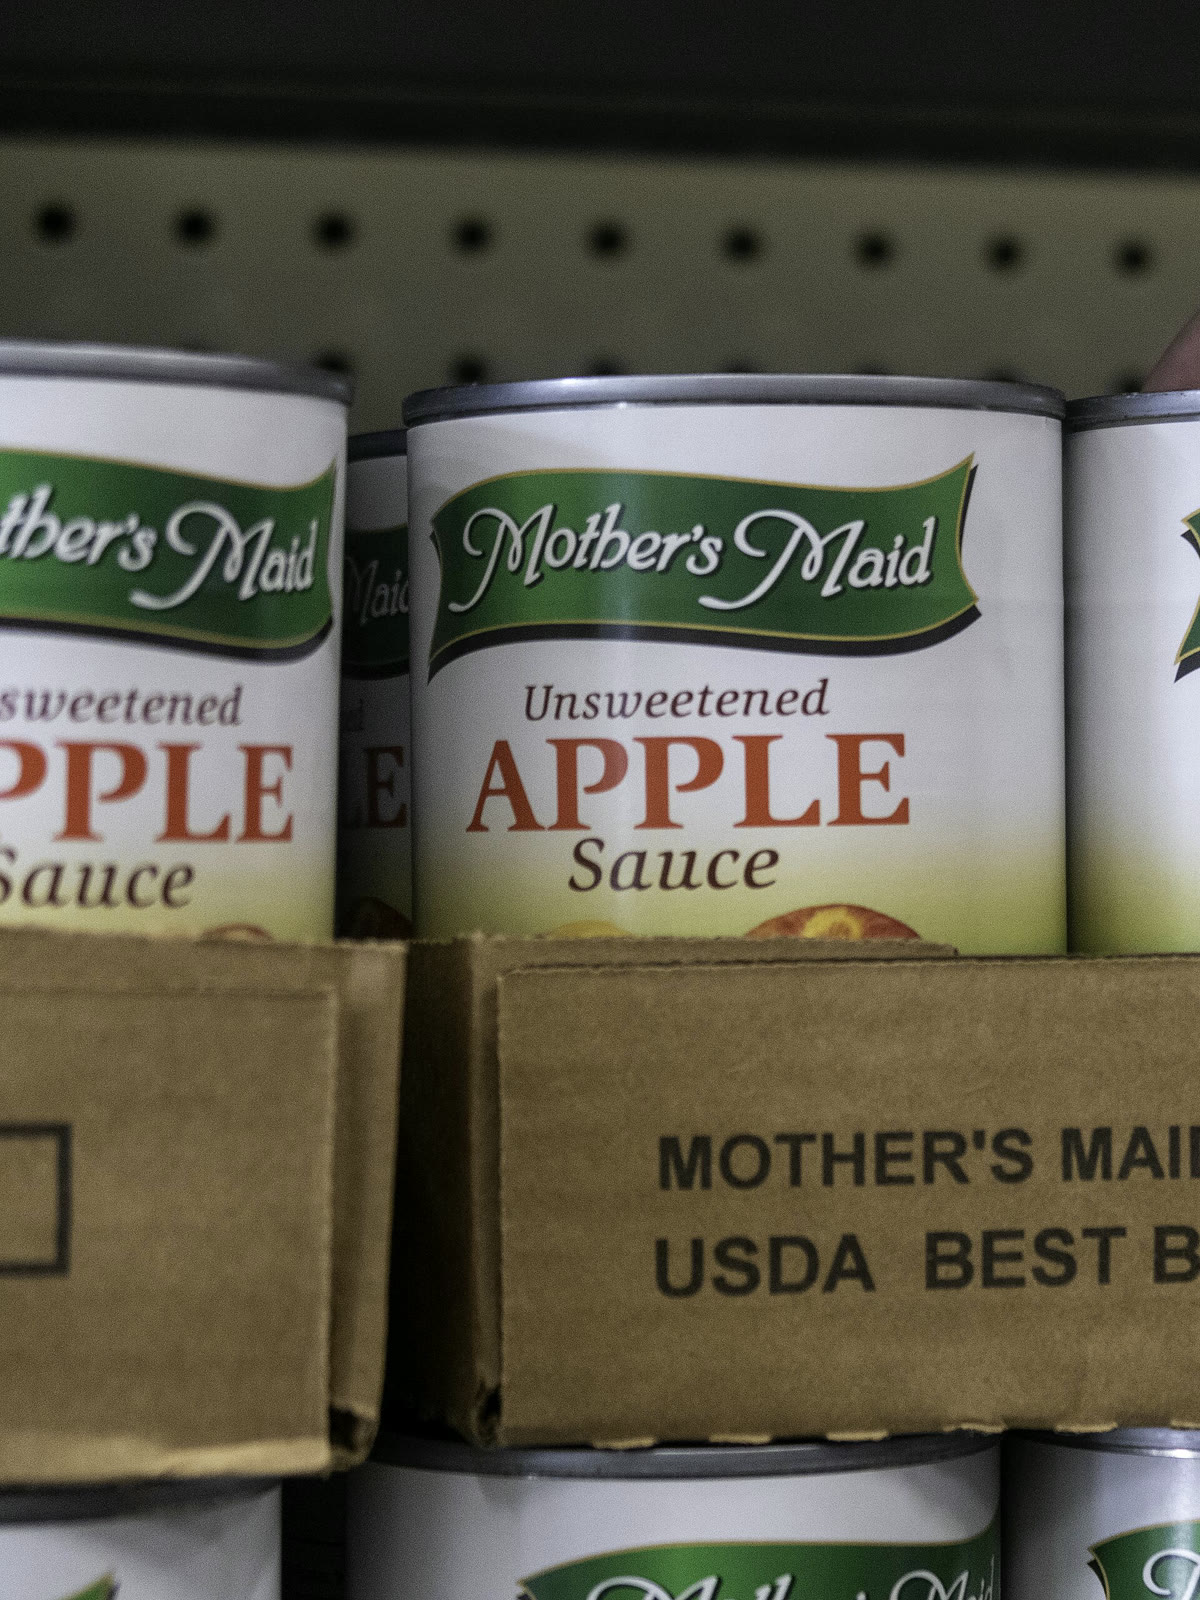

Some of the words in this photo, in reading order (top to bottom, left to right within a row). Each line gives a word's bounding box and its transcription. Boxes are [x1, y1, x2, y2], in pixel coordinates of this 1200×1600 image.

[0, 486, 157, 572] ther's
[130, 502, 318, 608] Maid
[449, 503, 724, 612] Mother's
[698, 509, 936, 610] Maid
[0, 684, 243, 726] sweetened
[524, 678, 830, 722] Unsweetened
[465, 733, 910, 832] APPLE
[568, 837, 779, 892] Sauce
[657, 1126, 1035, 1192] MOTHER'S
[654, 1233, 876, 1299] USDA
[924, 1225, 1126, 1291] BEST
